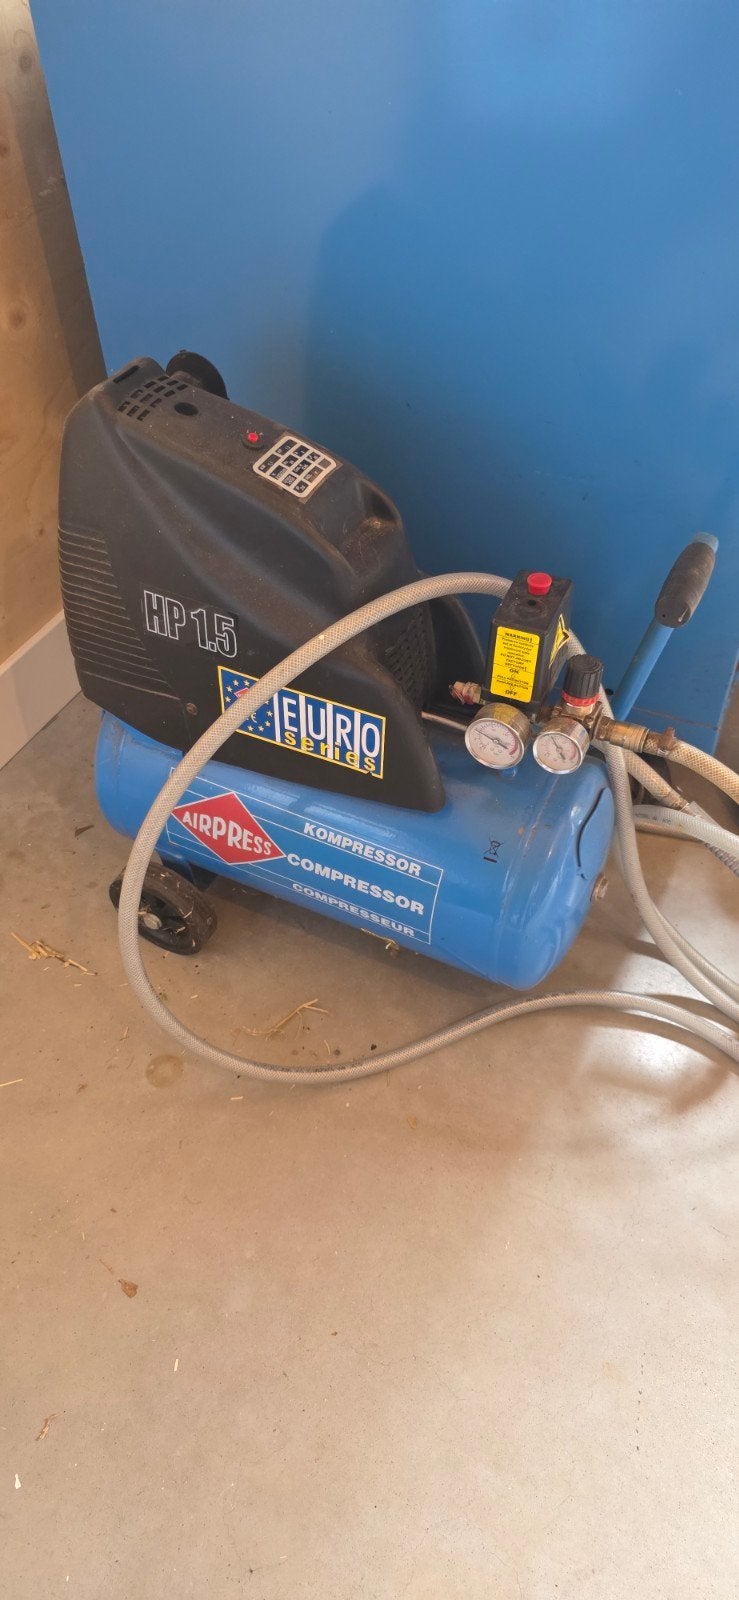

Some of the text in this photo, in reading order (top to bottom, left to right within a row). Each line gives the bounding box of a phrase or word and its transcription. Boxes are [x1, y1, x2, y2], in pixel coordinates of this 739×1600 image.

[143, 590, 238, 658] HP 1.5
[283, 697, 381, 758] EURO
[285, 731, 376, 773] series
[182, 810, 272, 855] AIRPRESS
[303, 822, 422, 877] KOMPRESSOR
[286, 853, 425, 916] COMPRESSOR
[292, 883, 416, 937] COMPRESSEUR
